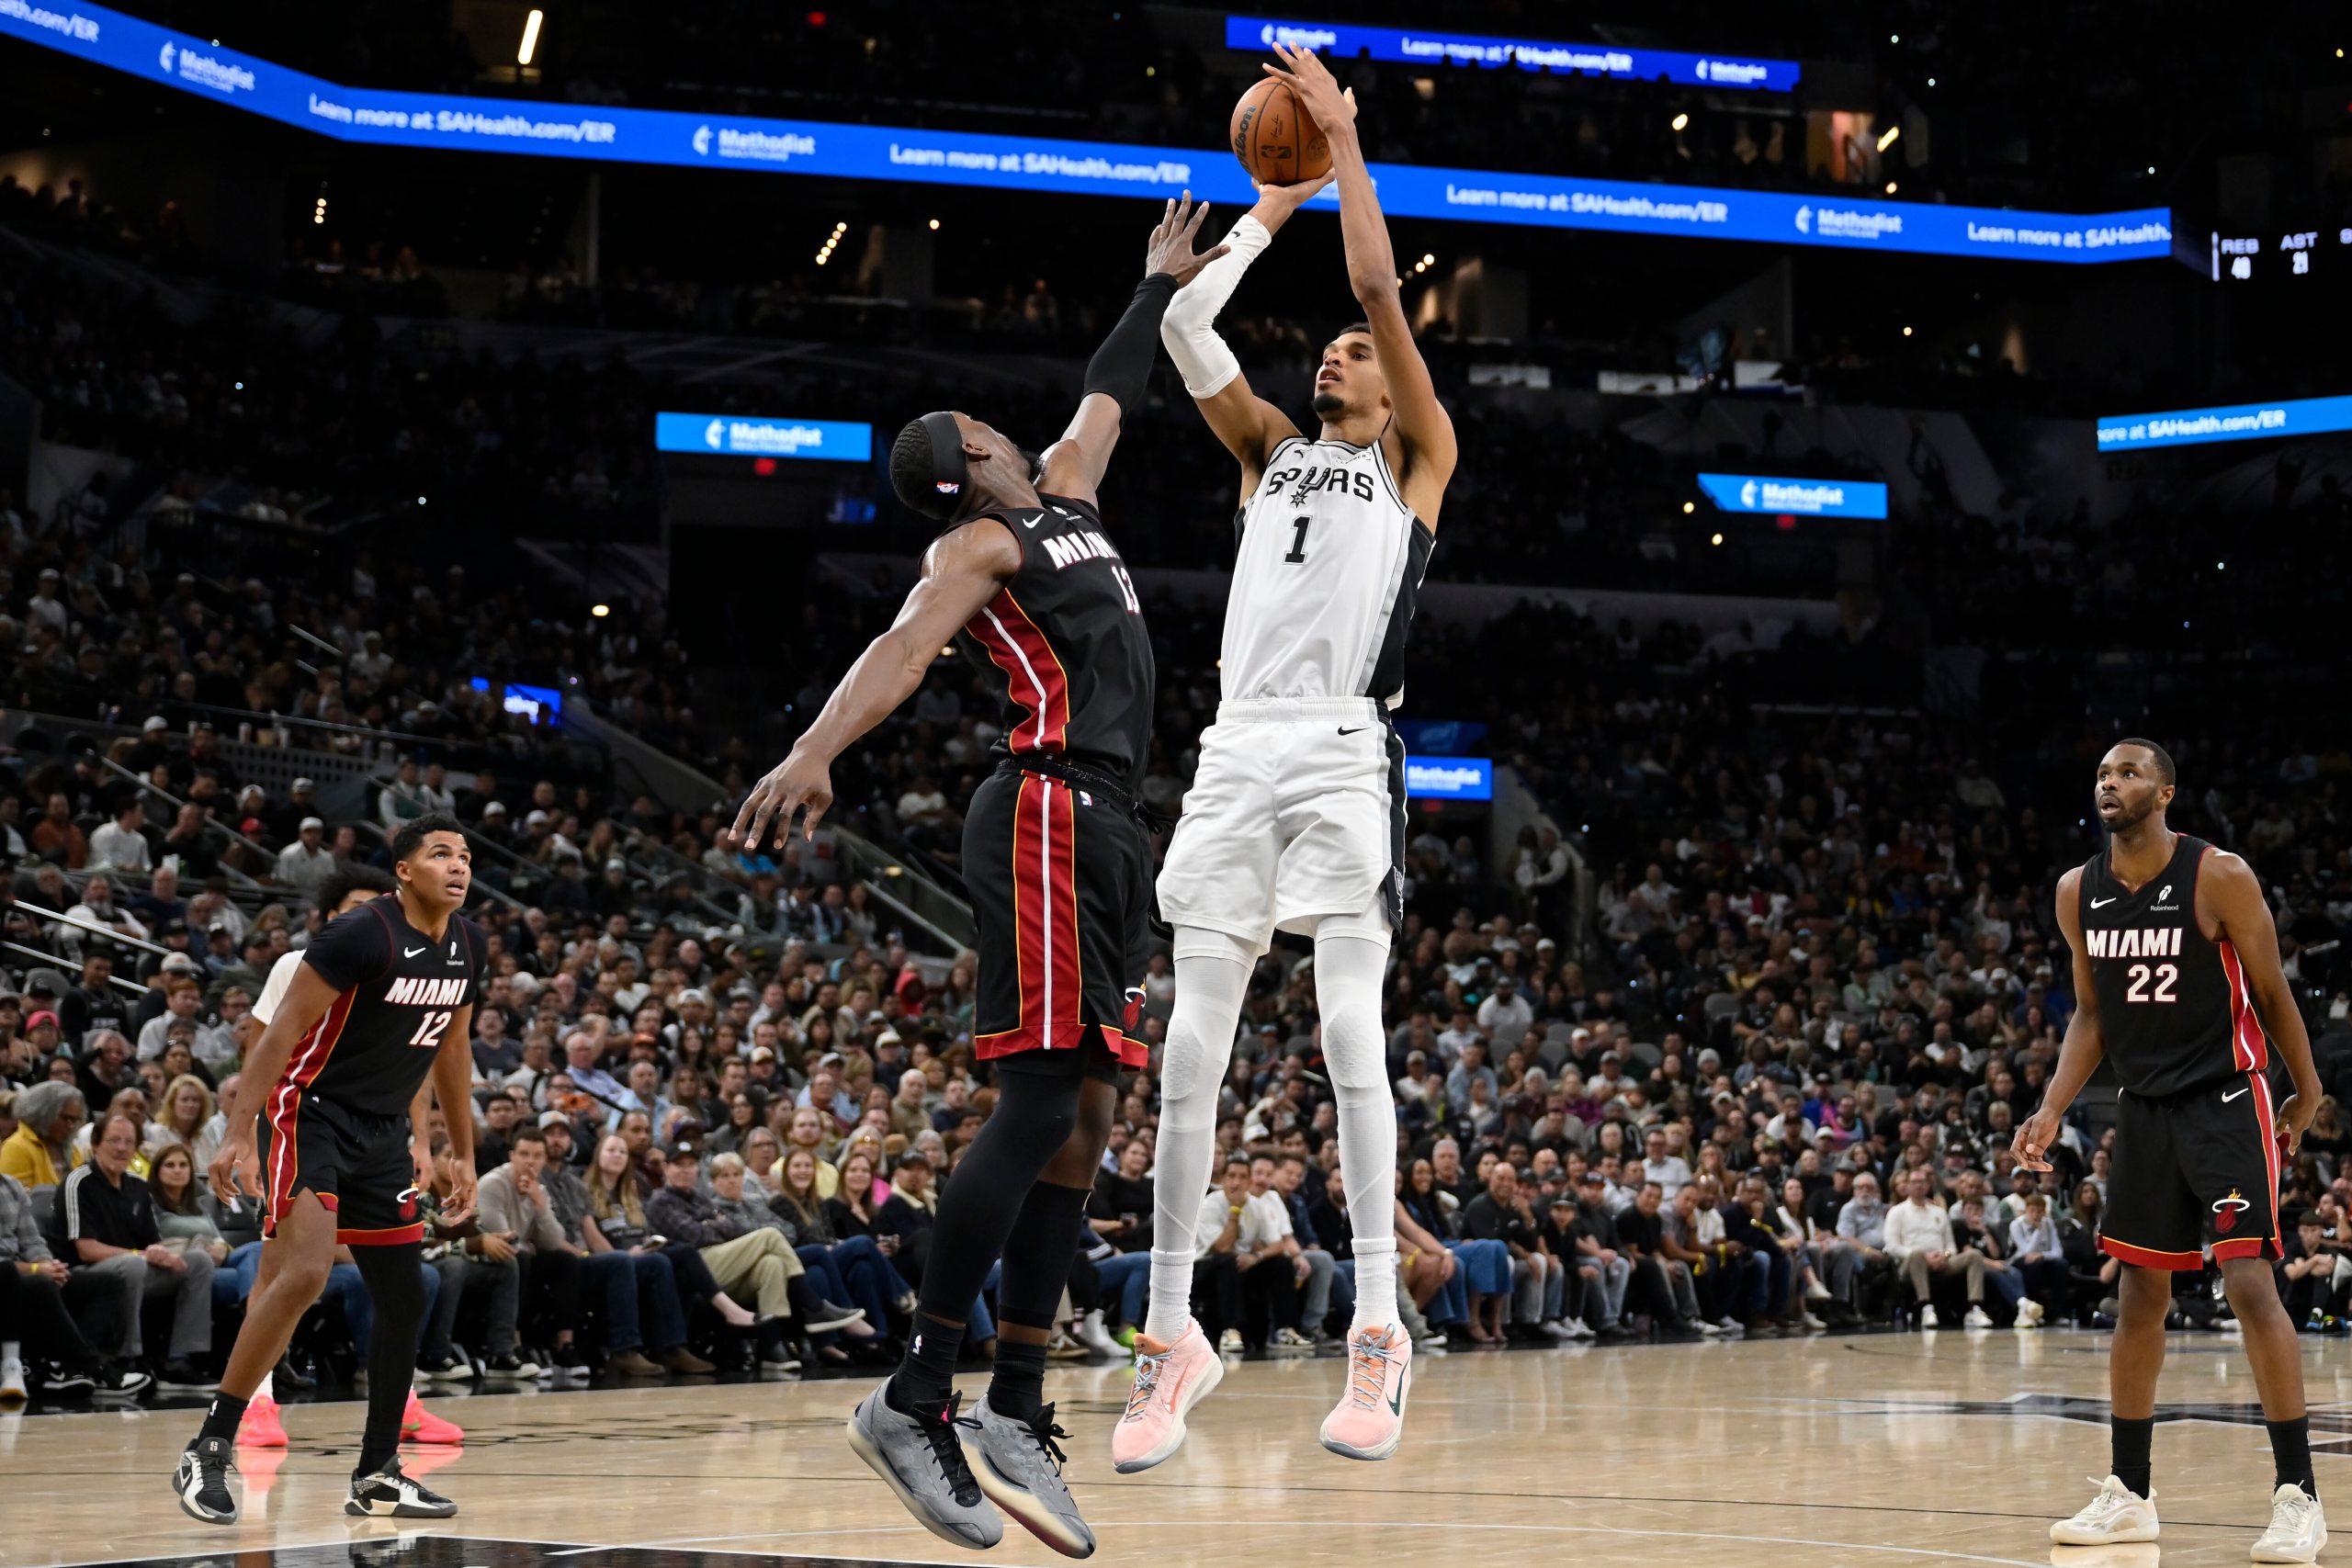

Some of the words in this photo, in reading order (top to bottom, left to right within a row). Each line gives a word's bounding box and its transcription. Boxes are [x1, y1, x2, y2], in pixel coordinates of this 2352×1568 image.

[309, 93, 353, 124] Learn
[354, 107, 409, 129] more
[411, 111, 435, 130] at
[435, 109, 616, 143] SAHealth.com/ER
[718, 129, 816, 154] Methodist
[889, 143, 945, 165] Learn
[945, 151, 998, 171] more
[999, 153, 1021, 173] at
[1023, 152, 1191, 185] SAHealth.com/ER
[1446, 184, 1498, 206] Learn
[1499, 191, 1547, 210] more
[1548, 193, 1569, 211] at
[1570, 191, 1728, 222] SAHealth.com/ER
[1817, 209, 1903, 233] Methodist
[1968, 222, 2016, 243] Learn
[2017, 229, 2061, 248] more
[2062, 231, 2083, 248] at
[2221, 238, 2260, 254] REB
[2279, 231, 2318, 251] AST
[729, 422, 822, 447] Methodist
[2128, 424, 2147, 440] at
[2148, 410, 2286, 439] SAHealth.com/ER
[1265, 465, 1374, 503] SPURS
[1761, 483, 1844, 506] Methodist
[1282, 514, 1313, 566] 1
[1110, 565, 1140, 615] 13
[1407, 765, 1482, 785] Methodist
[2086, 928, 2183, 958] MIAMI
[383, 976, 469, 1006] MIAMI
[2126, 964, 2178, 1002] 22
[407, 1010, 453, 1047] 12
